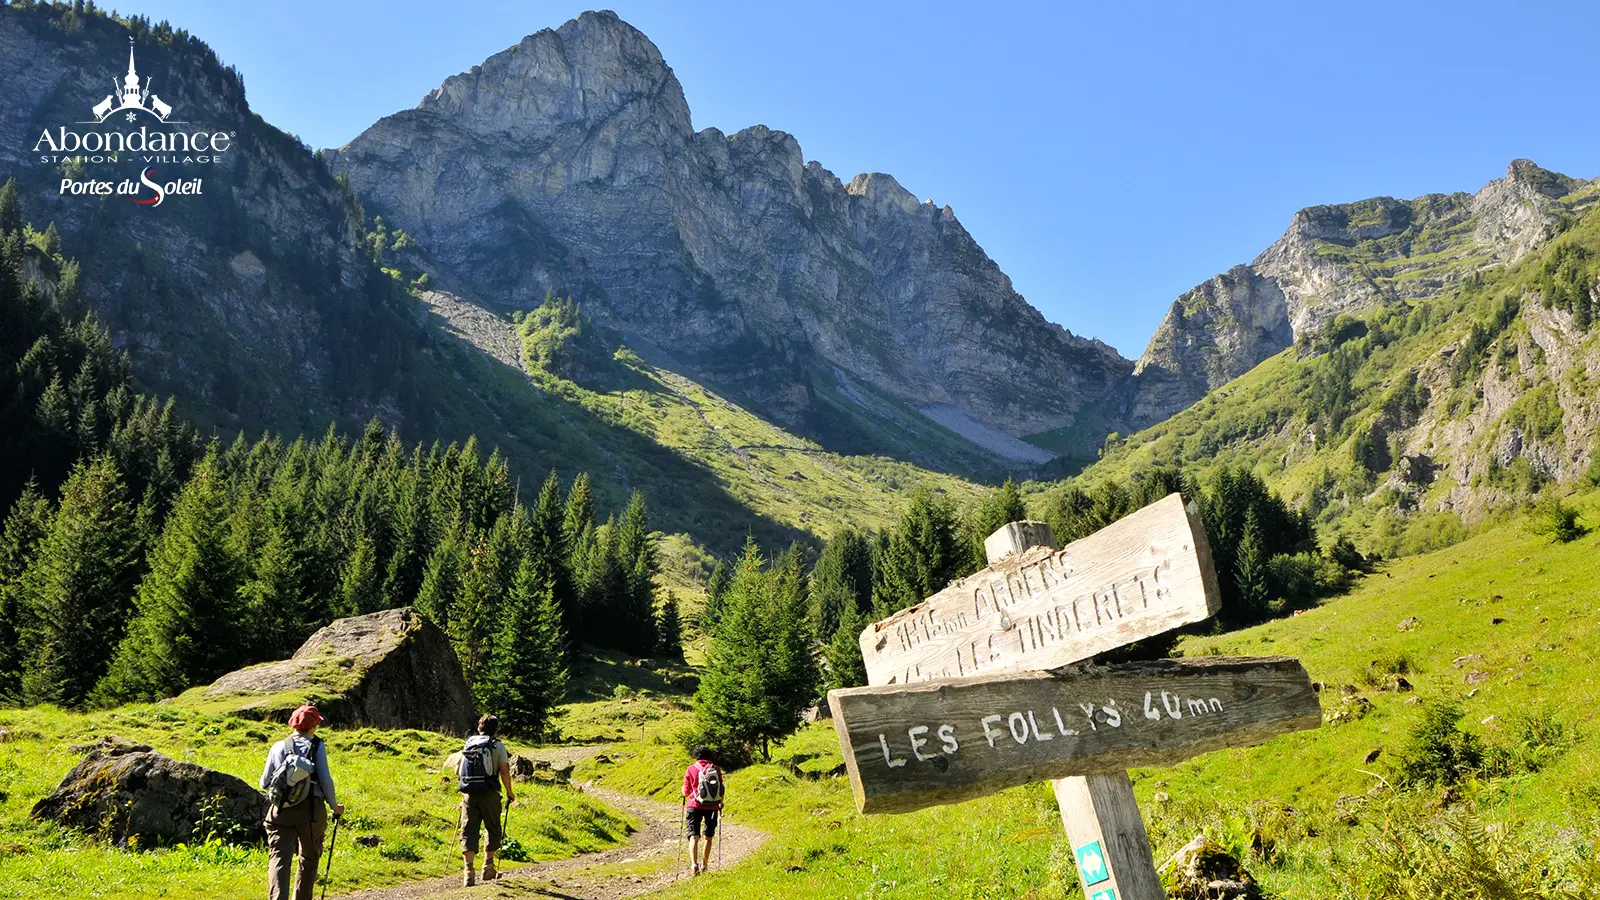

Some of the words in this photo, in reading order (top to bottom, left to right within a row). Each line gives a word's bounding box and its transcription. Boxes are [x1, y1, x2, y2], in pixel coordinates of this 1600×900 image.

[956, 633, 1001, 676] LES
[878, 714, 959, 768] LES
[981, 697, 1122, 747] FOLLYS
